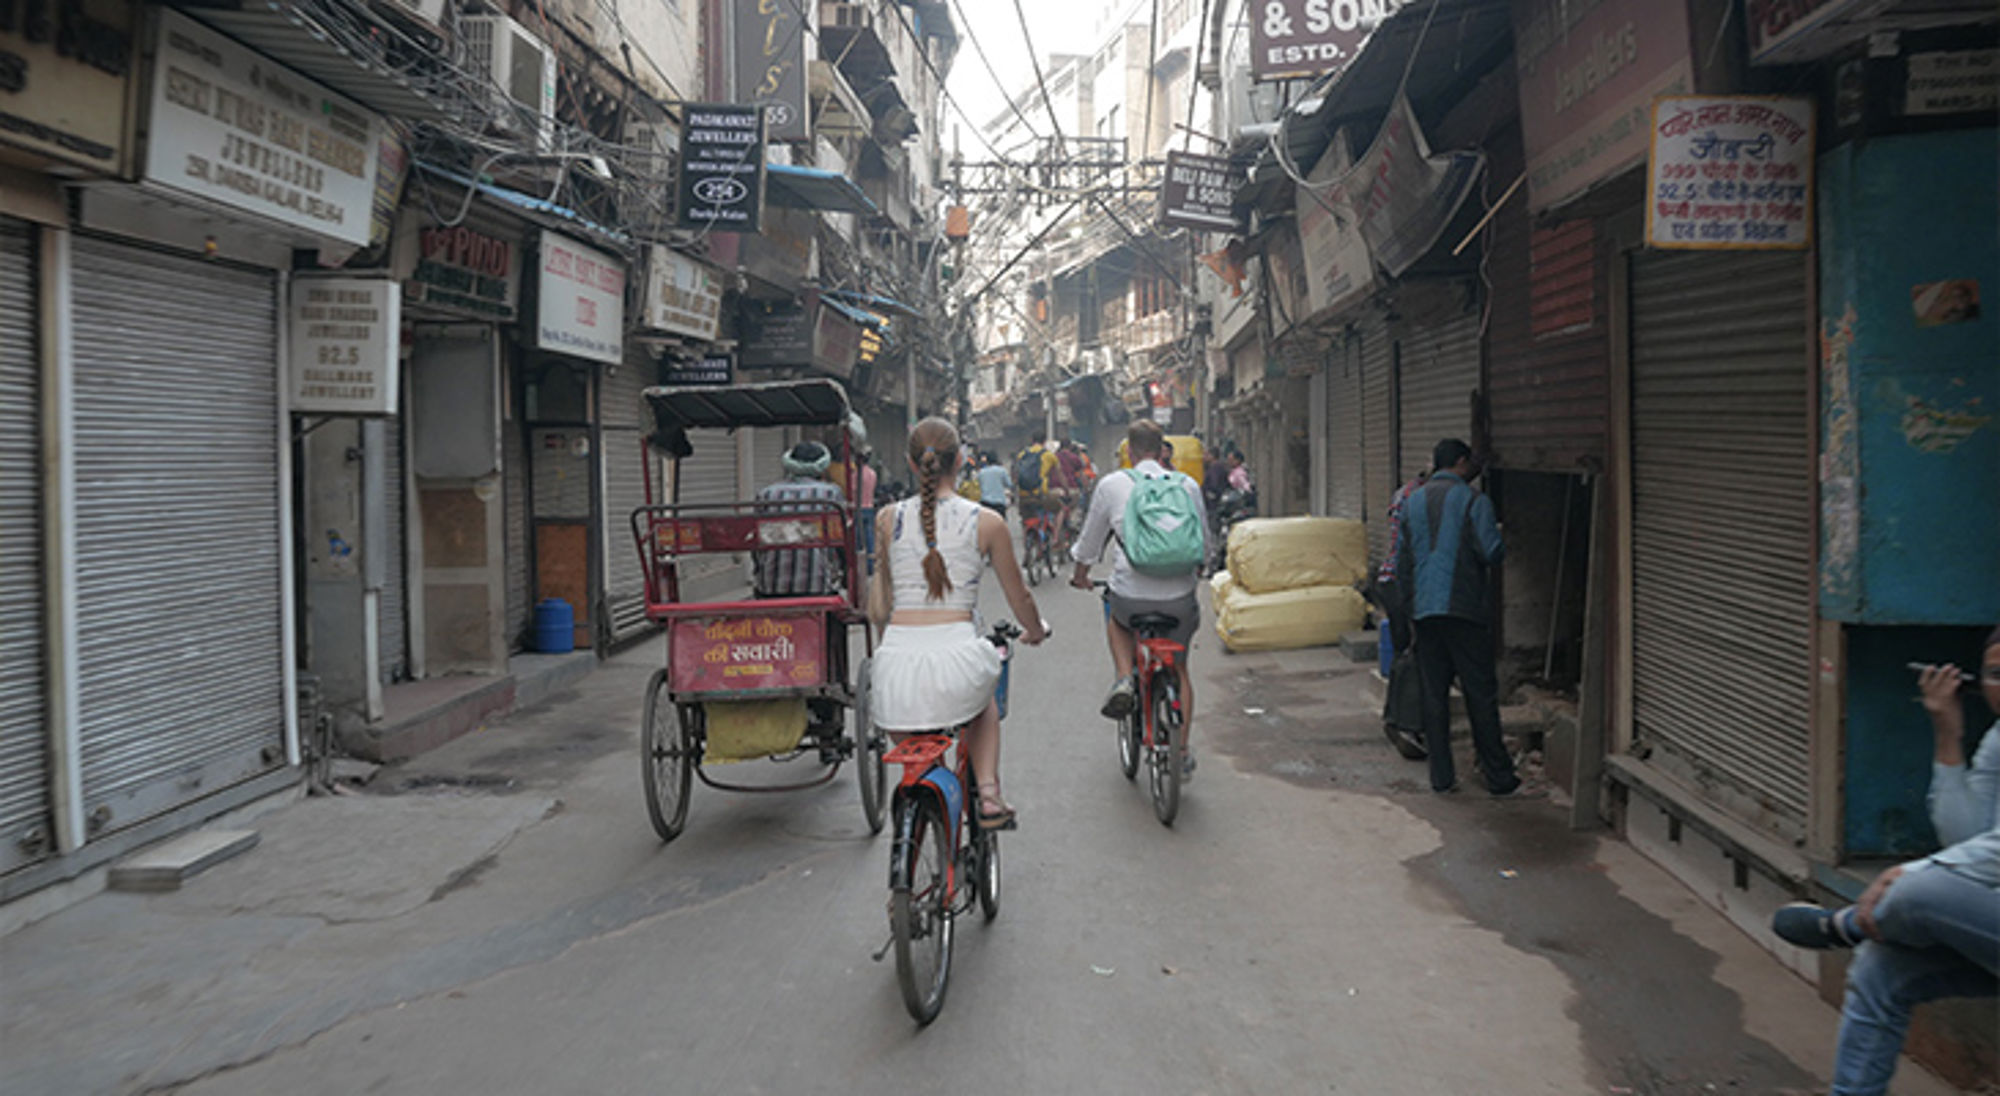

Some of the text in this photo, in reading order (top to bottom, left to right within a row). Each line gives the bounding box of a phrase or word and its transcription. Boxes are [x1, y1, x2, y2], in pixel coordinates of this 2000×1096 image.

[1264, 2, 1293, 37] &
[1268, 43, 1346, 64] ESTD.
[688, 131, 759, 144] JEWELLERS
[1690, 130, 1775, 160] जौहरी
[221, 132, 324, 194] JEWELLERS
[318, 345, 359, 365] 92.5
[703, 642, 729, 664] की
